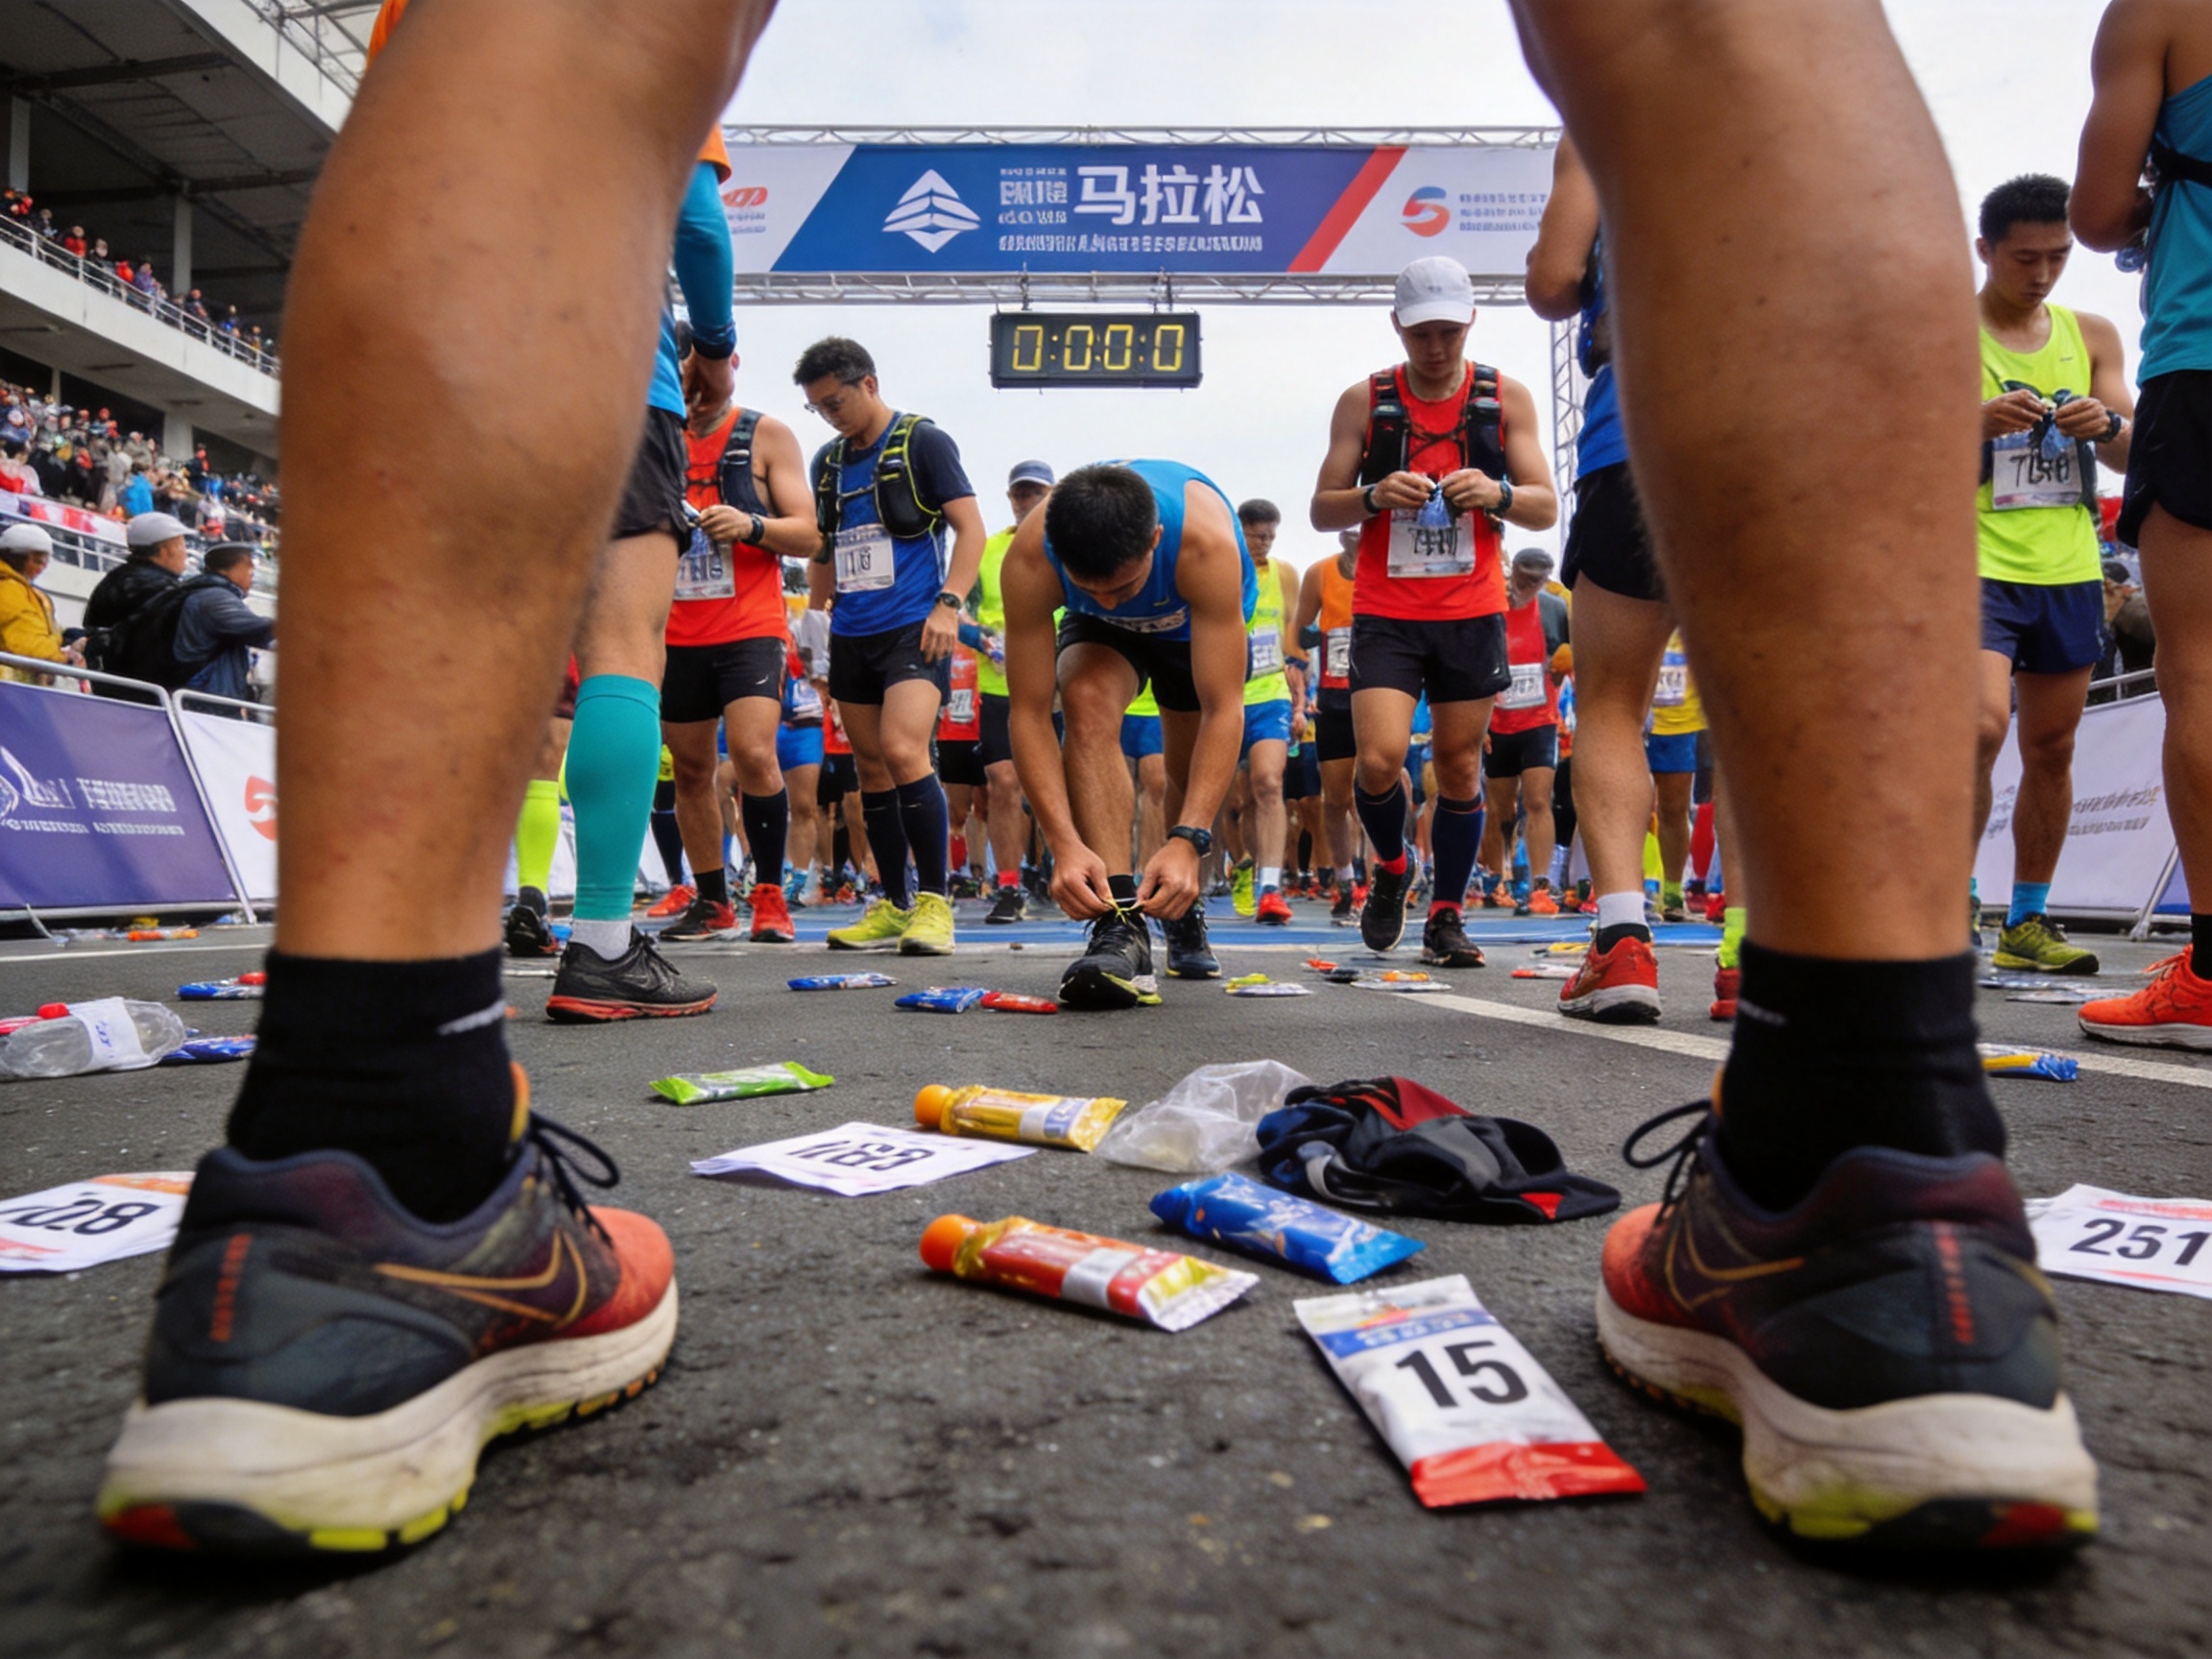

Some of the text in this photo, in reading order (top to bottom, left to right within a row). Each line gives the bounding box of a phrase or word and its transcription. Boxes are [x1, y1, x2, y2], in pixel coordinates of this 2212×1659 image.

[1073, 164, 1265, 226] 马拉松
[2068, 1217, 2212, 1266] 251
[1394, 1340, 1529, 1407] 15
